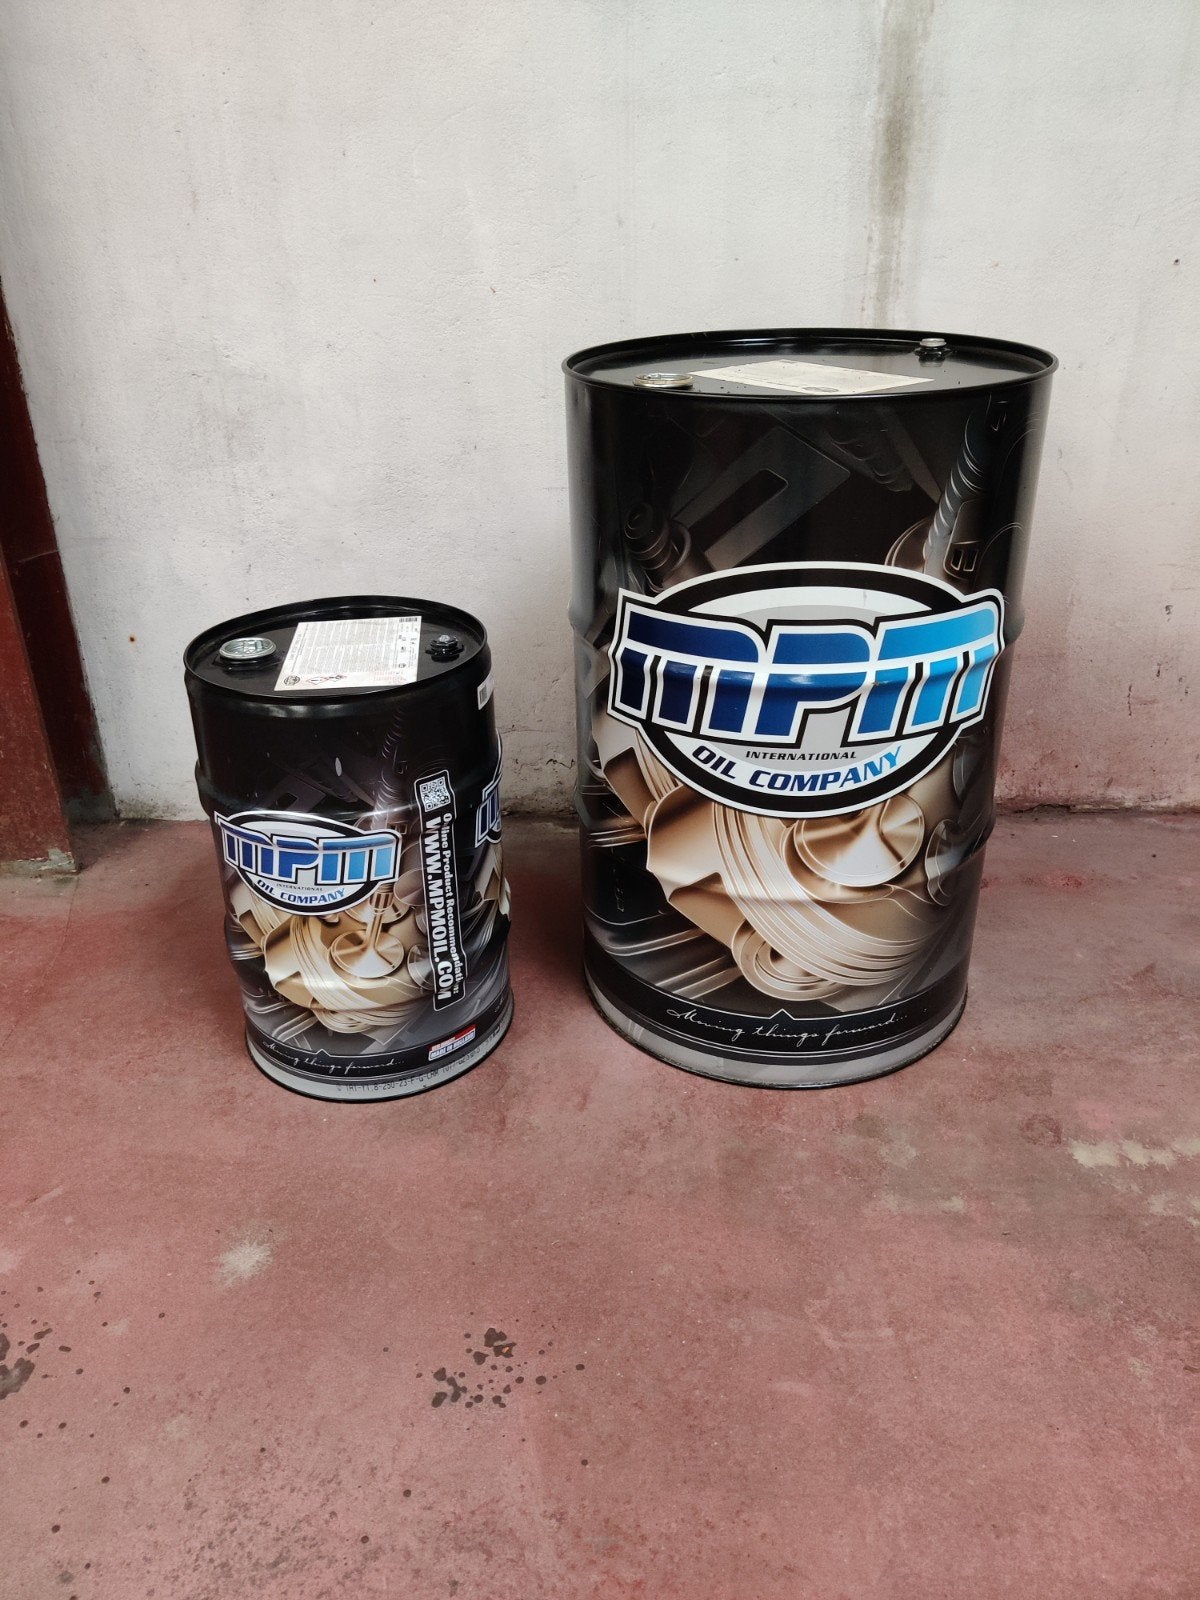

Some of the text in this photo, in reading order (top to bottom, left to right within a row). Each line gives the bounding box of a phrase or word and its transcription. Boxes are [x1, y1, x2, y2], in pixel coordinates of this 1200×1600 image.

[613, 600, 1000, 745] MPM
[691, 744, 903, 793] OIL COMPANY
[745, 749, 858, 761] INTERNATIONAL
[221, 821, 398, 886] MPM
[442, 849, 455, 898] Product
[256, 878, 348, 904] OIL COMPANY
[276, 882, 324, 892] INTERNATIONAL
[424, 816, 454, 1001] WWW.MPMOIL.COM
[666, 1007, 746, 1043] Moving
[752, 1022, 820, 1048] things
